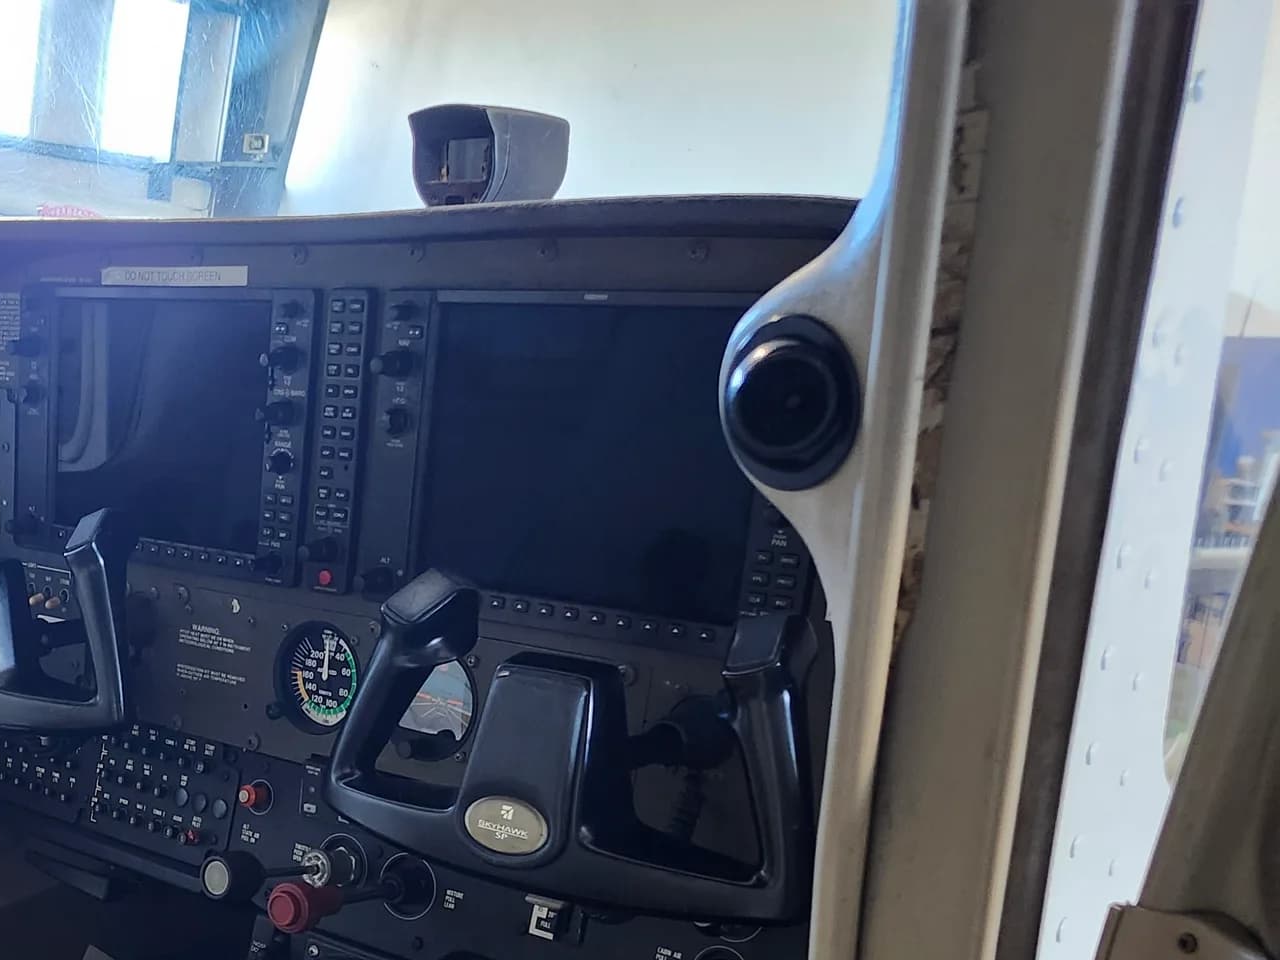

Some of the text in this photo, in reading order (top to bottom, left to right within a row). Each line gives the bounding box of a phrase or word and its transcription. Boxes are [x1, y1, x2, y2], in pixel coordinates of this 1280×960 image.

[137, 271, 154, 281] NOT
[157, 271, 184, 281] TOUCH
[192, 624, 220, 635] WARNING
[335, 652, 345, 661] 40
[341, 668, 351, 677] 60
[305, 682, 317, 691] 140
[311, 695, 323, 703] 120
[326, 699, 338, 708] 100
[478, 819, 528, 838] SKYHAWK
[495, 832, 508, 840] SP
